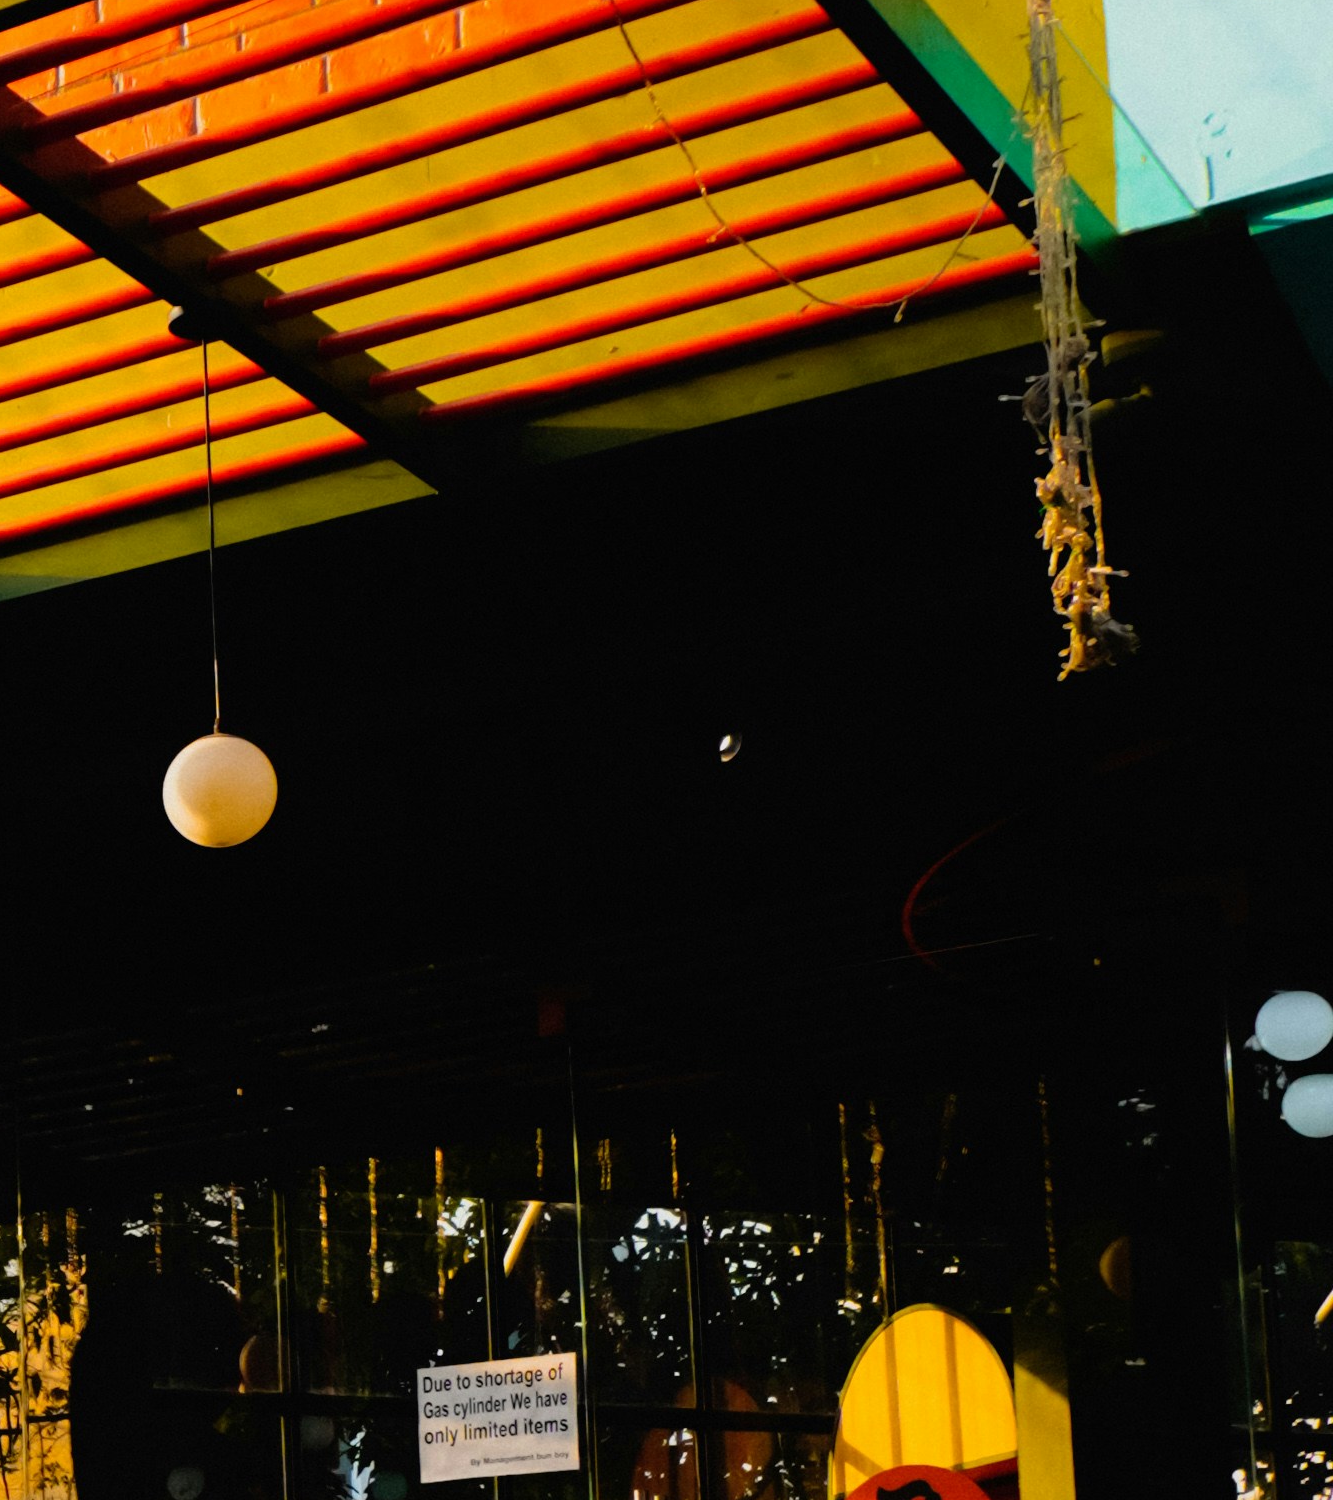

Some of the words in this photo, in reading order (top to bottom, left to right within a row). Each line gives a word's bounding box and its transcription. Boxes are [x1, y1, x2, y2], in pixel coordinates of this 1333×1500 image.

[423, 1376, 452, 1393] Due
[456, 1375, 471, 1390] to
[475, 1369, 543, 1388] shortage
[548, 1362, 563, 1381] of
[423, 1402, 449, 1419] Gas
[453, 1396, 506, 1419] cylinder
[510, 1393, 531, 1409] We
[535, 1391, 568, 1408] have
[424, 1427, 458, 1447] only
[464, 1419, 518, 1441] limited
[523, 1418, 569, 1435] items
